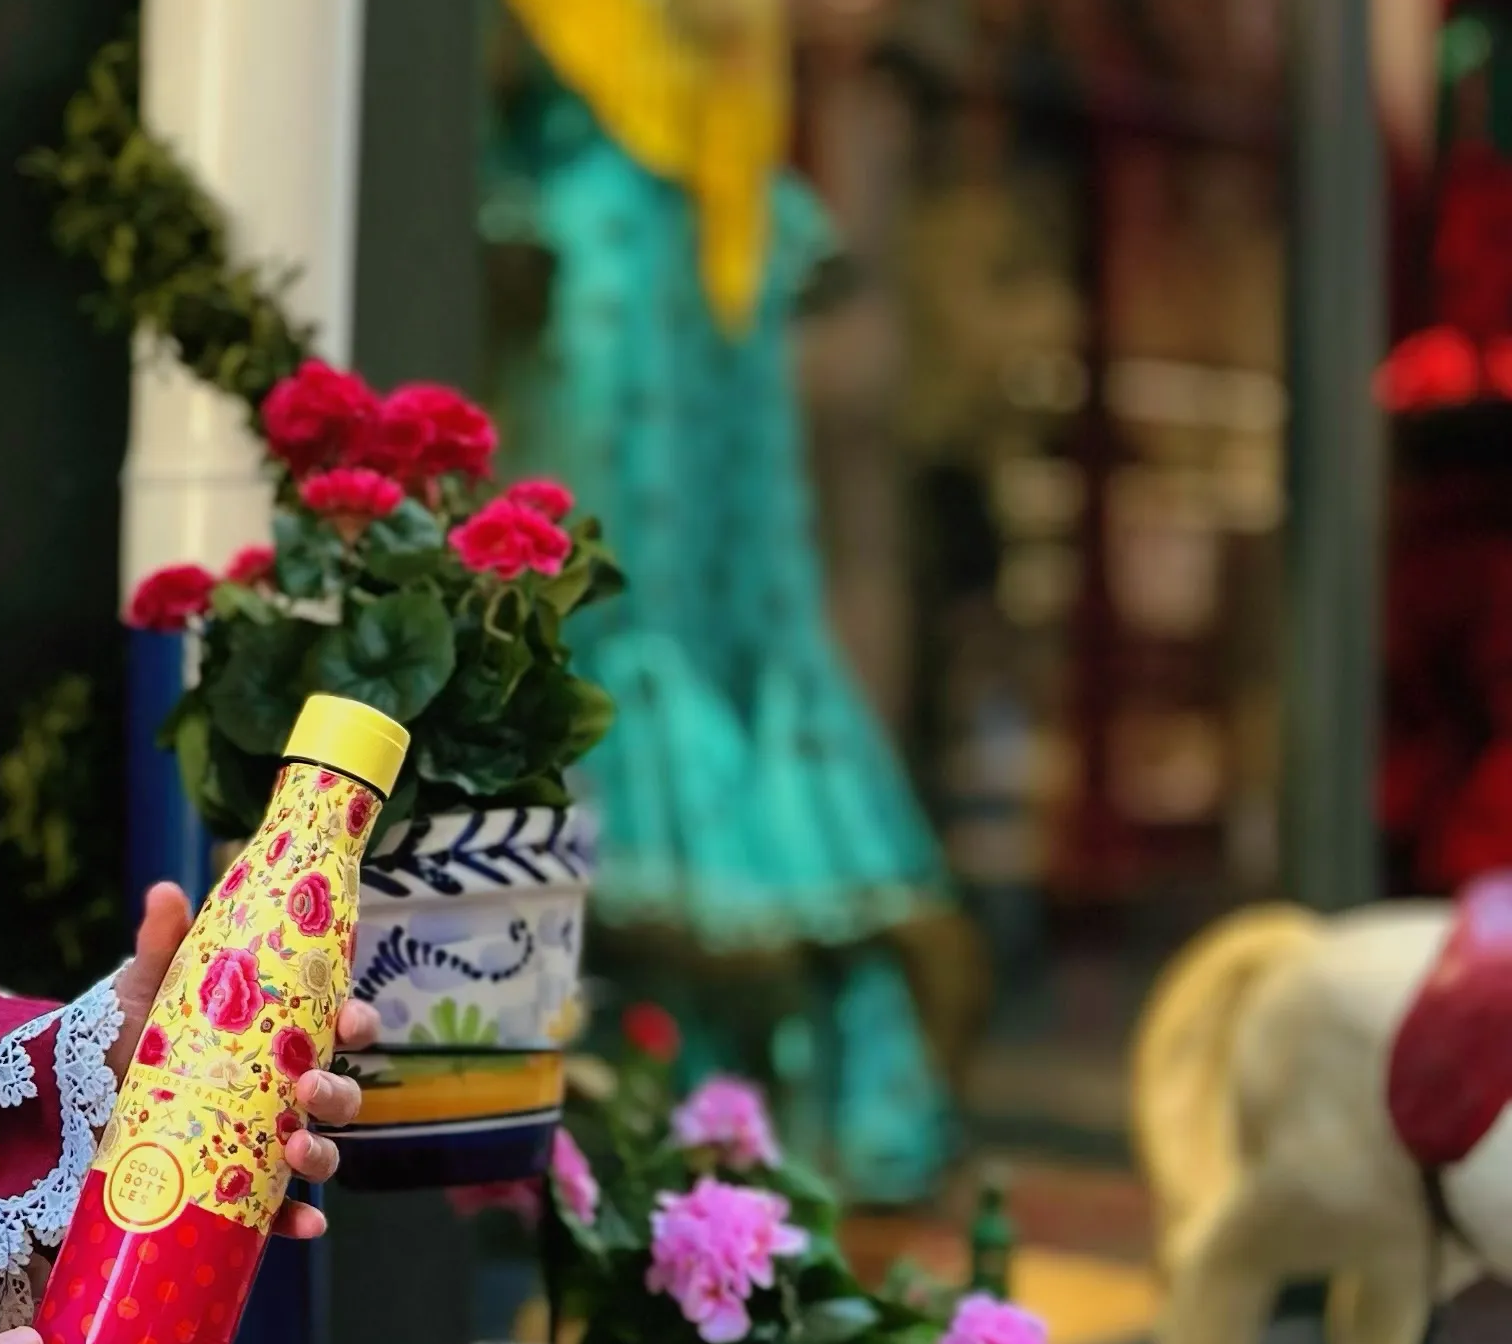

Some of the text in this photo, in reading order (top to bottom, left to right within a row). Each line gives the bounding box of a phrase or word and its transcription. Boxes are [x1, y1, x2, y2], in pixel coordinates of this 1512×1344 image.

[129, 1159, 168, 1182] COOL
[124, 1172, 166, 1196] BOTT
[118, 1187, 148, 1205] LES
